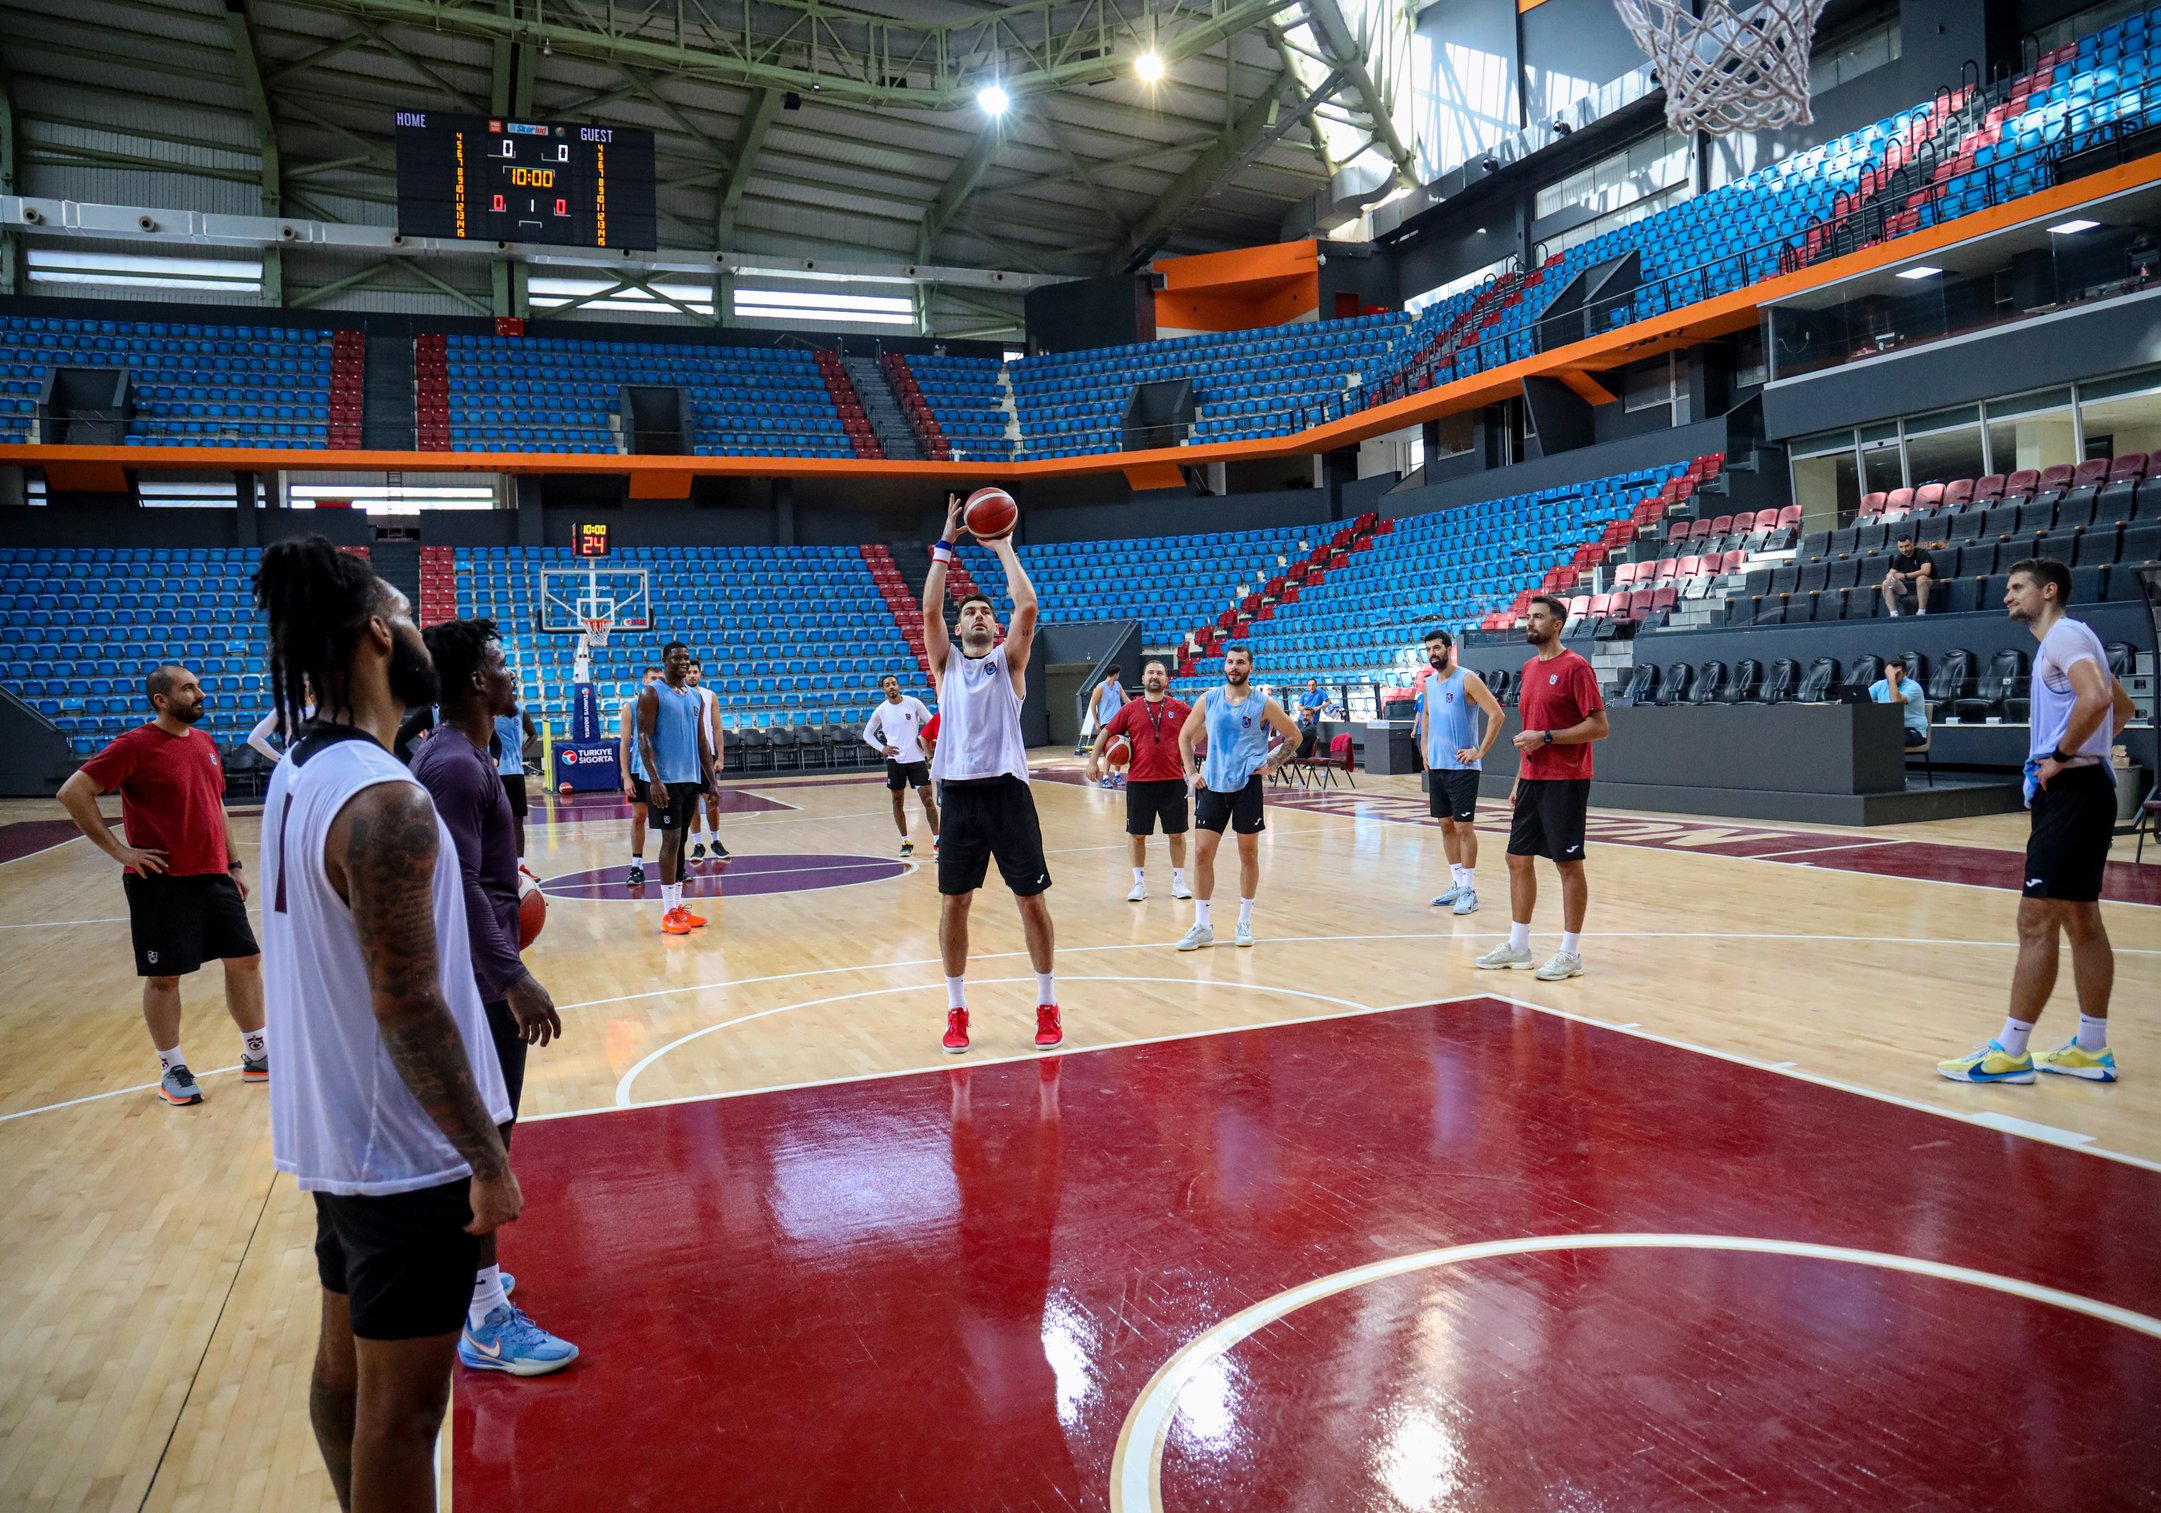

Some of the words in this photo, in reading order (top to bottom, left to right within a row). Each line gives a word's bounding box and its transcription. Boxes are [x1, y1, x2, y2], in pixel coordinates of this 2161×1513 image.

[396, 112, 426, 128] HOME
[580, 128, 612, 143] GUEST
[503, 140, 513, 157] 0
[558, 144, 568, 161] 0
[512, 168, 553, 188] 10:00
[456, 185, 463, 193] 10
[494, 195, 504, 210] 0
[530, 199, 534, 212] 1
[556, 199, 566, 214] 0
[597, 195, 604, 203] 10
[457, 229, 465, 237] 15
[598, 238, 605, 246] 15
[583, 525, 606, 534] 10:00
[582, 536, 604, 554] 24
